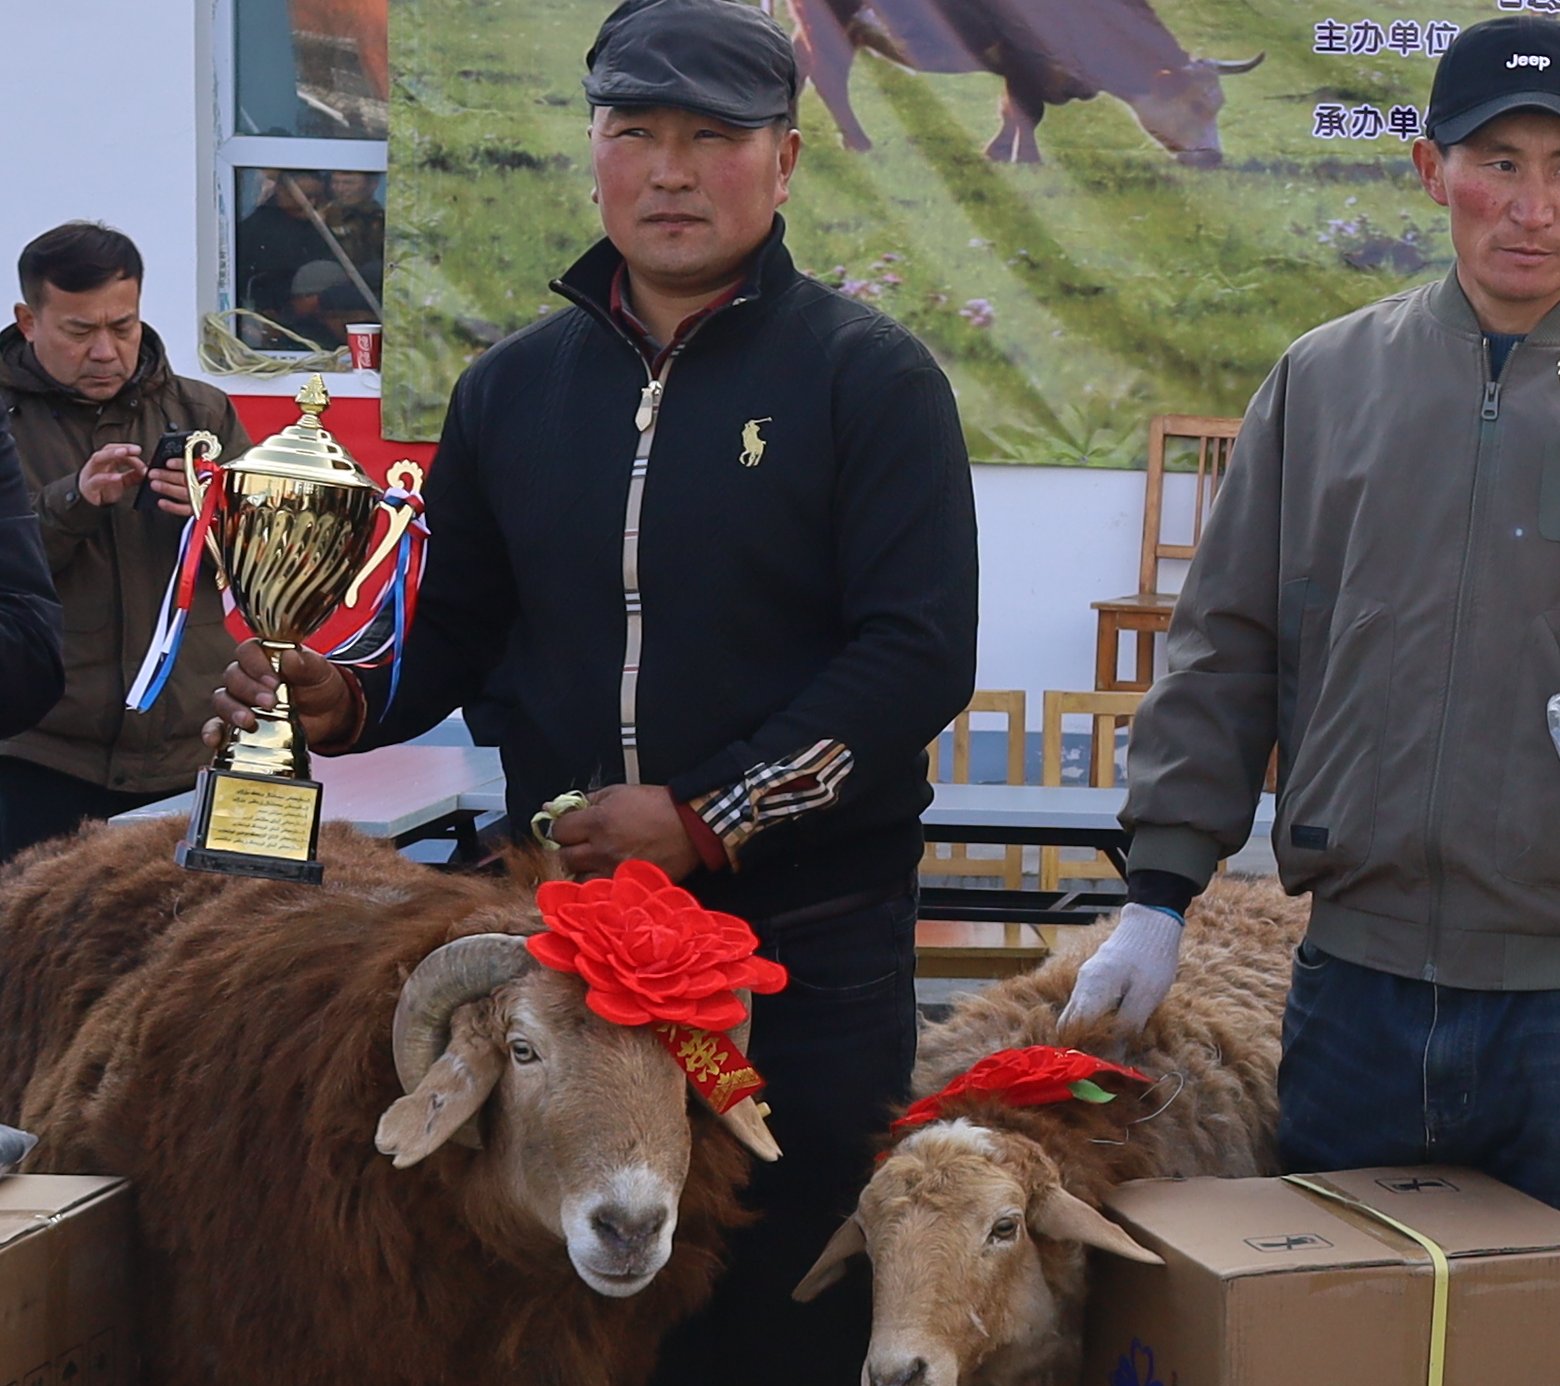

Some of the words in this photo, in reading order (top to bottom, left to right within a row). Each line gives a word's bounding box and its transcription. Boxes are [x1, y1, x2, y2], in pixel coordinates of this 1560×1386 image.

[1313, 19, 1459, 56] 主办单位
[1506, 54, 1551, 71] Jeep
[1312, 104, 1430, 140] 承办单
